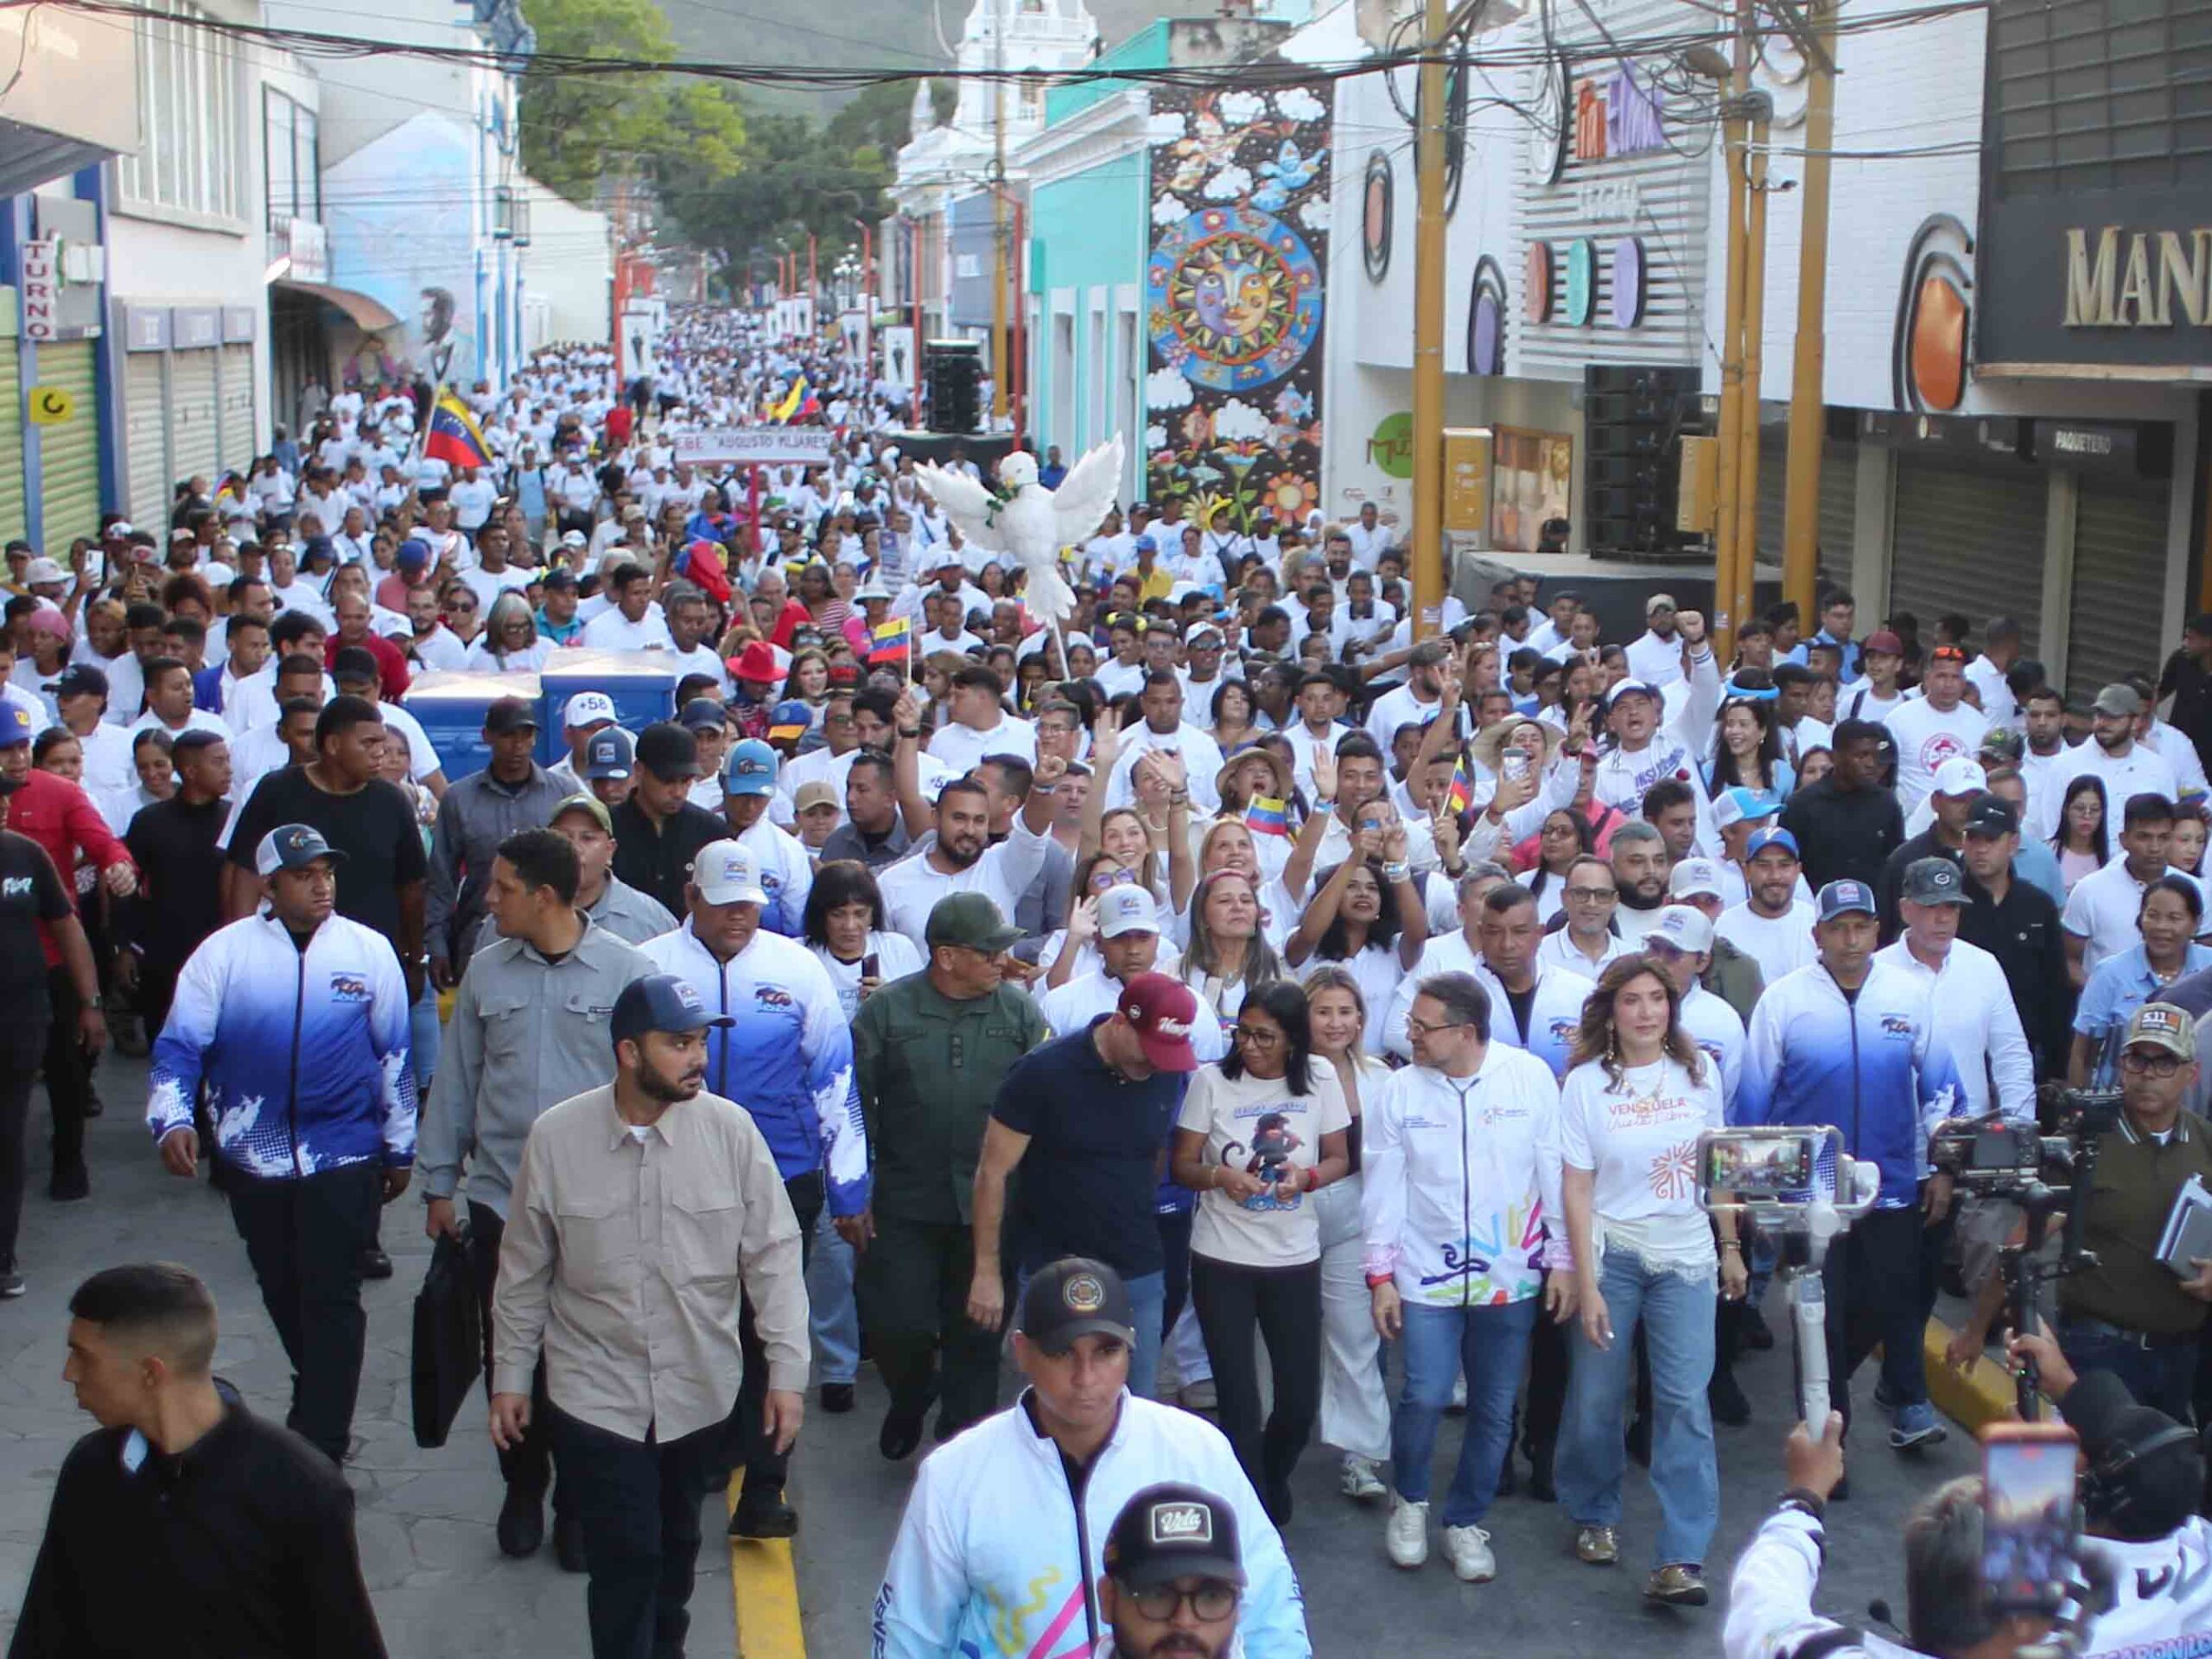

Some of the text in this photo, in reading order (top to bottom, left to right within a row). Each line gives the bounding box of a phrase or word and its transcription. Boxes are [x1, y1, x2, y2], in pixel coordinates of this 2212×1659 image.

[24, 245, 50, 338] TURNO
[2062, 228, 2212, 327] MAN
[580, 696, 607, 710] +58
[1608, 1096, 1688, 1116] VENUELA
